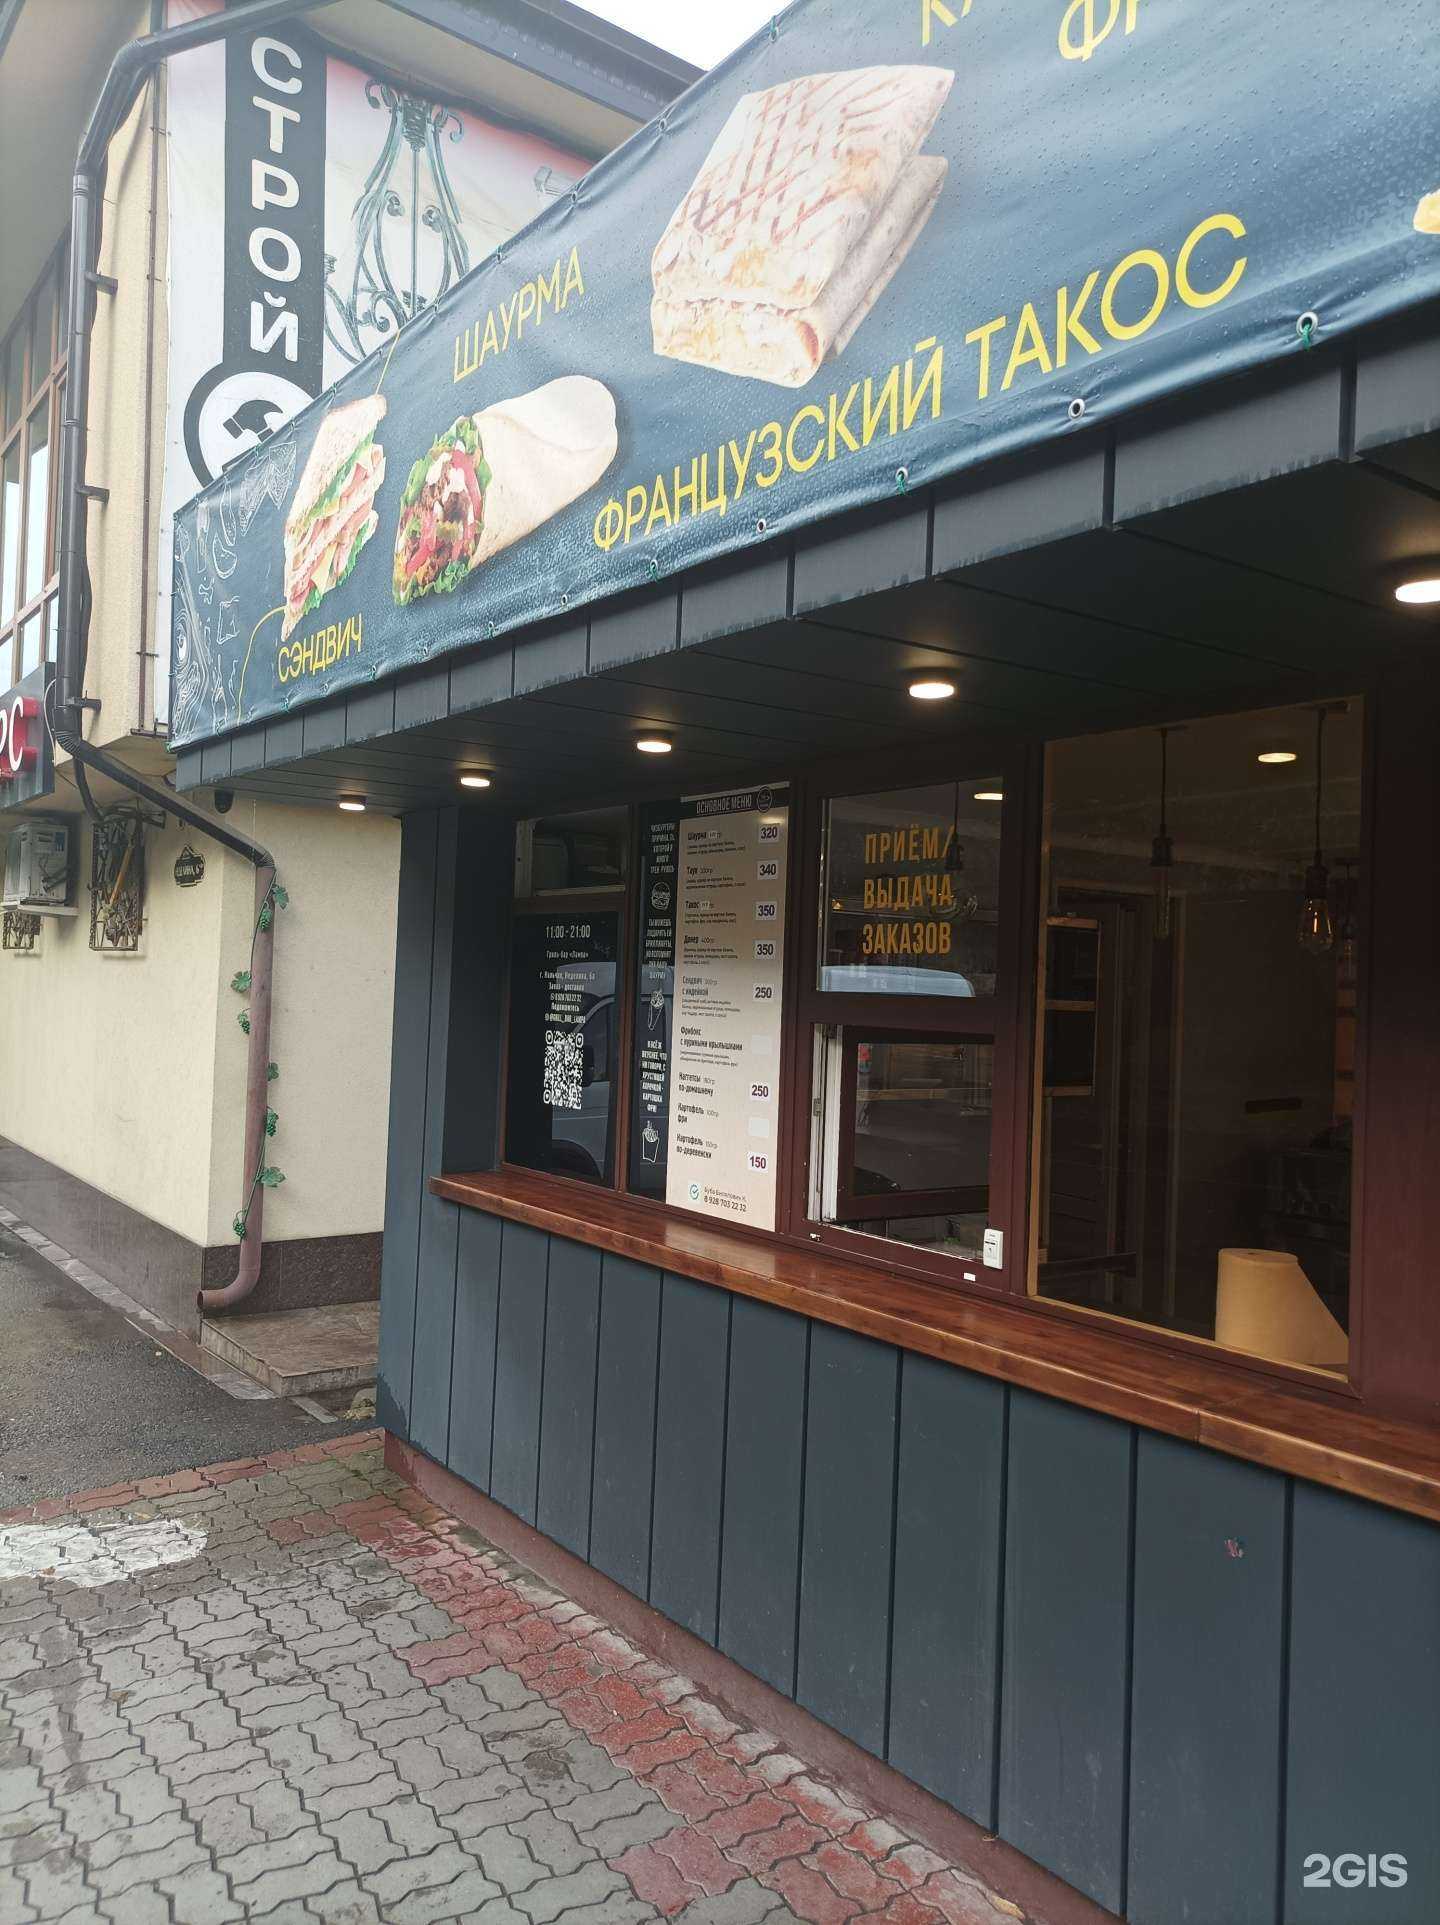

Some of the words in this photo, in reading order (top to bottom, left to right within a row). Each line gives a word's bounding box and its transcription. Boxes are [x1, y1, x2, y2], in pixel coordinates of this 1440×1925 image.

[249, 37, 302, 362] СТРОЙ
[454, 246, 585, 384] ШАУРМА
[593, 335, 944, 552] ФРАНЦУЗСКИЙ
[965, 213, 1247, 400] ТАКОС
[278, 613, 362, 682] СЭНДВИЧ
[696, 799, 730, 815] ОСНОВНОЕ
[731, 794, 752, 810] МЕНЮ
[761, 826, 778, 839] 320
[759, 863, 777, 876] 340
[863, 874, 954, 912] ВЫДАЧА
[758, 904, 775, 917] 350
[570, 925, 591, 938] 21:00
[862, 921, 951, 955] ЗАКАЗОВ
[756, 944, 774, 956] 350
[755, 986, 773, 999] 250
[751, 1085, 769, 1097] 250
[678, 1103, 704, 1115] Картофель
[677, 1133, 703, 1146] Картофель
[750, 1156, 767, 1169] 150
